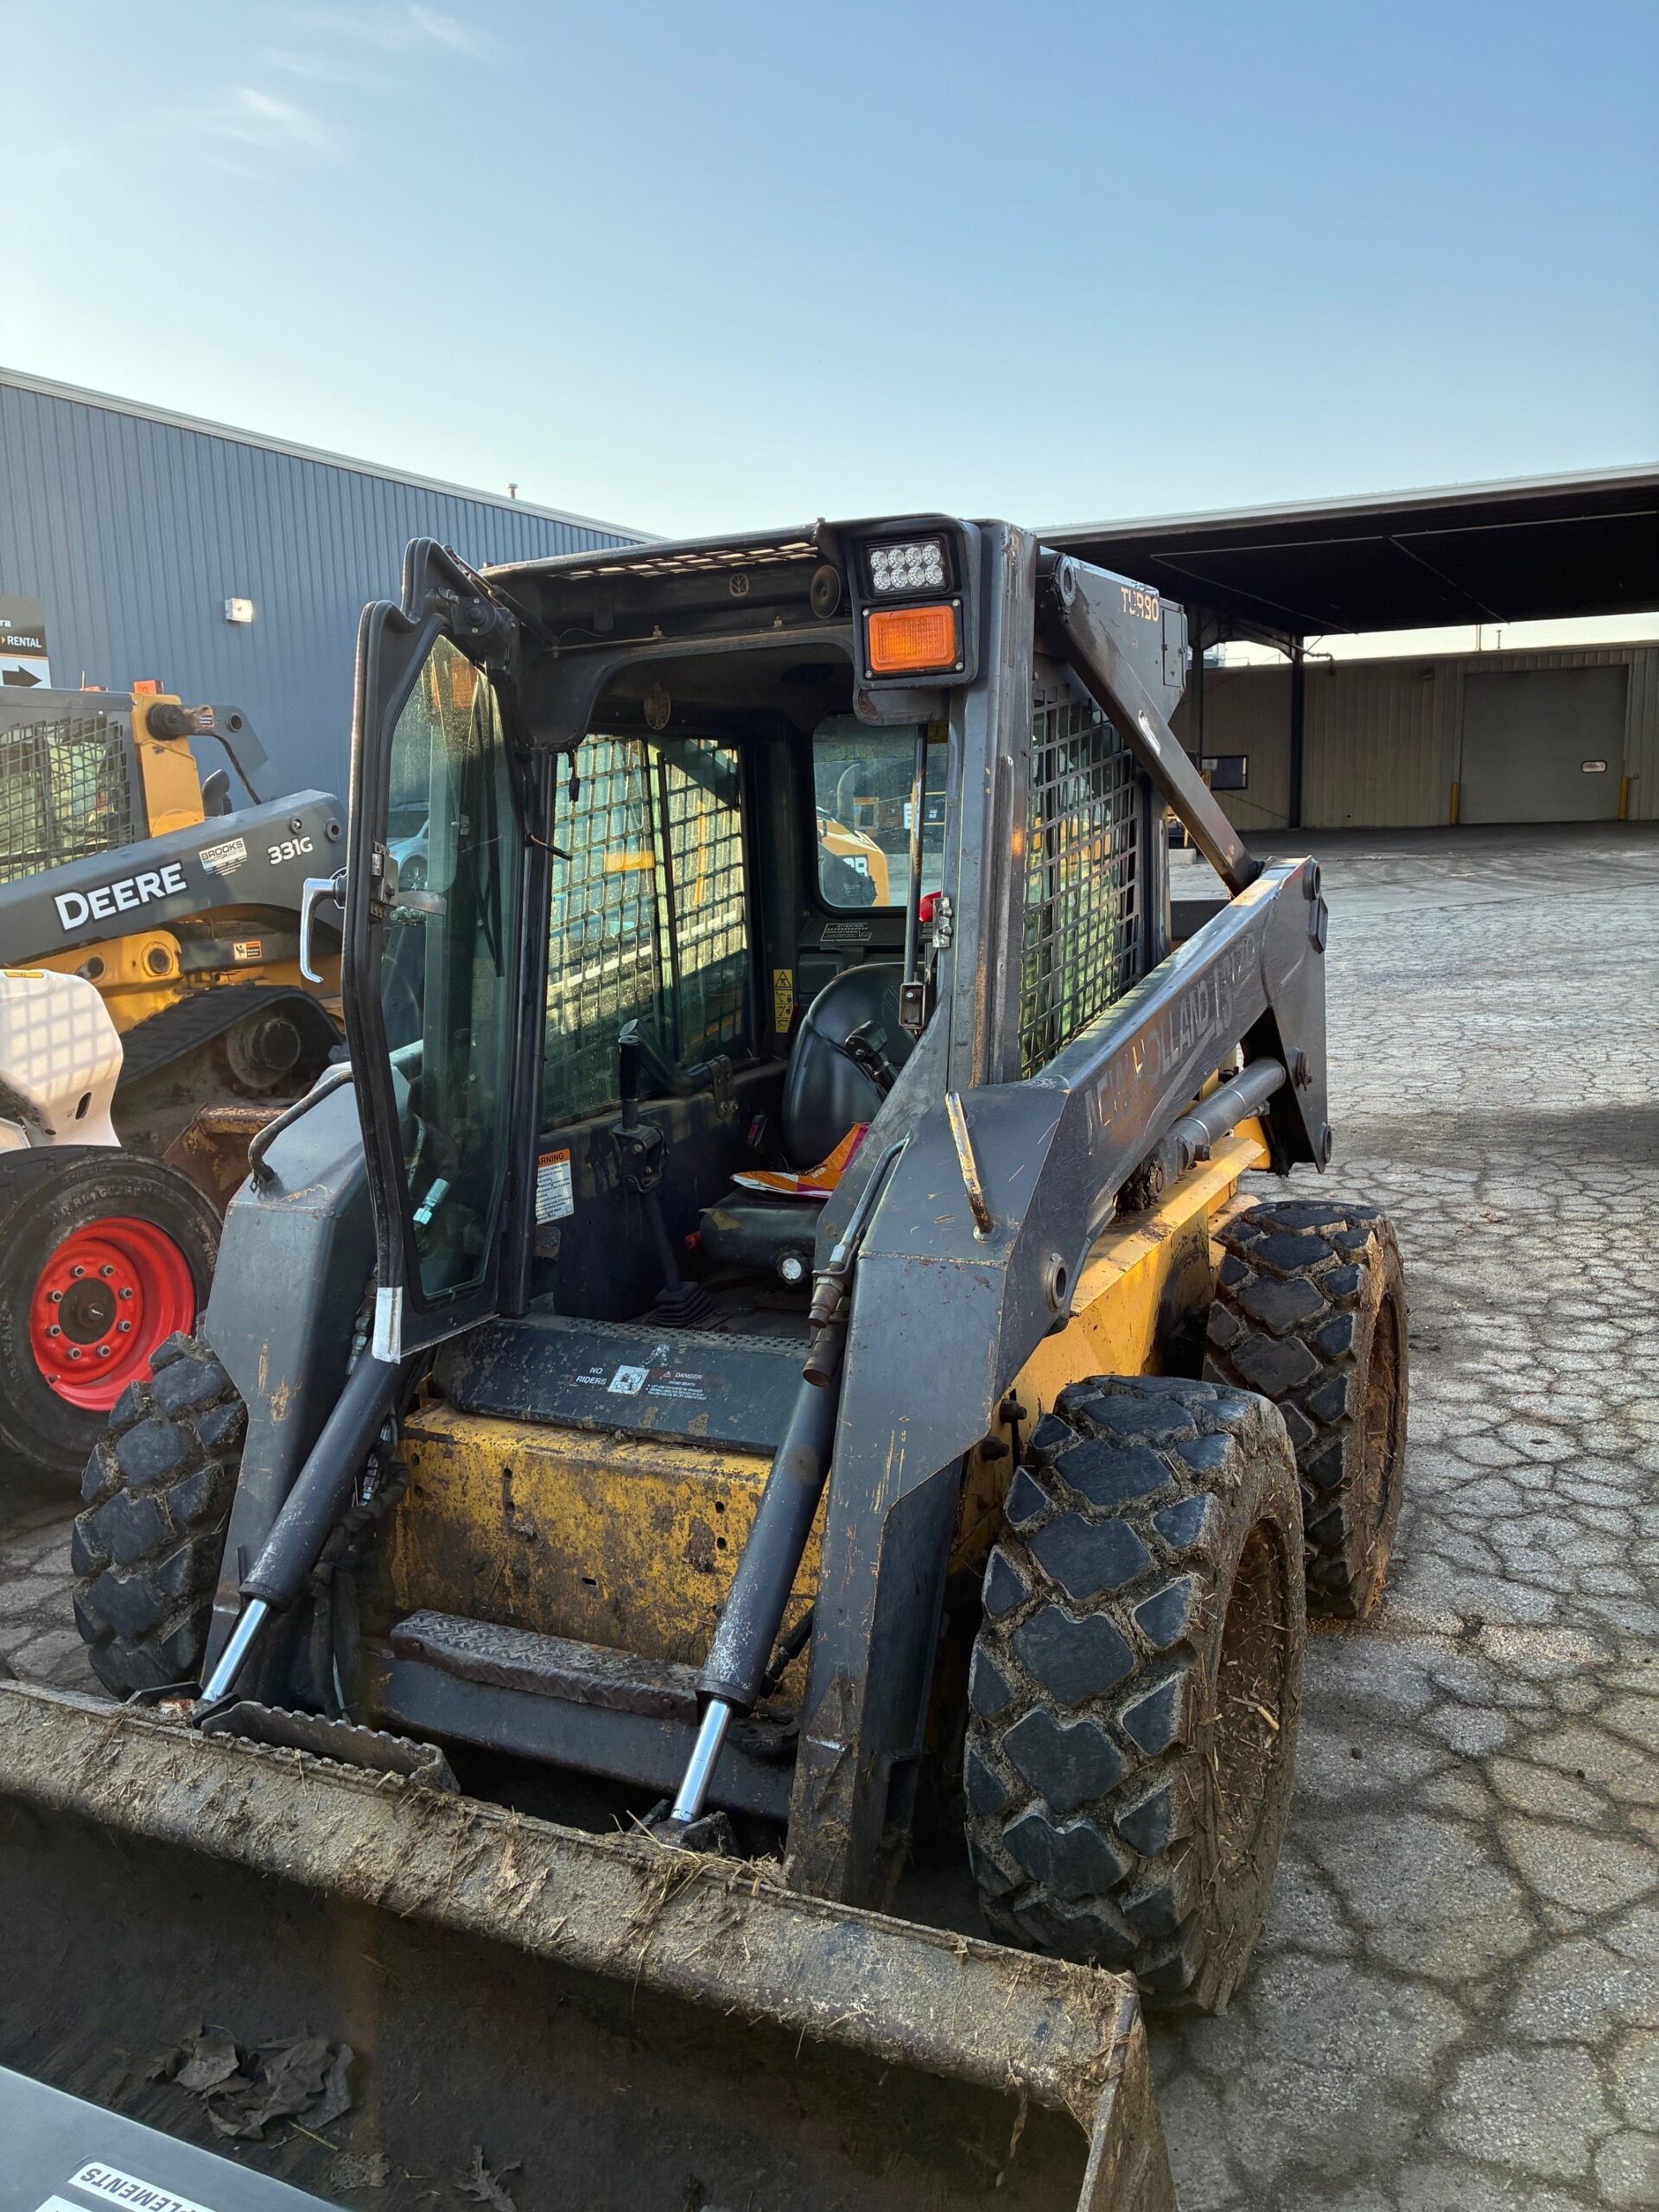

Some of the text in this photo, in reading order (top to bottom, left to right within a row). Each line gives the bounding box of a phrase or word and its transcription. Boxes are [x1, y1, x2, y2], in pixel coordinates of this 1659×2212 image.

[7, 635, 41, 648] RENTAL
[201, 840, 243, 861] BROOKS
[267, 836, 313, 865] 331G
[54, 862, 188, 931] DEERE
[576, 1376, 607, 1385] RIDERS
[80, 2168, 196, 2212] LEMENTS
